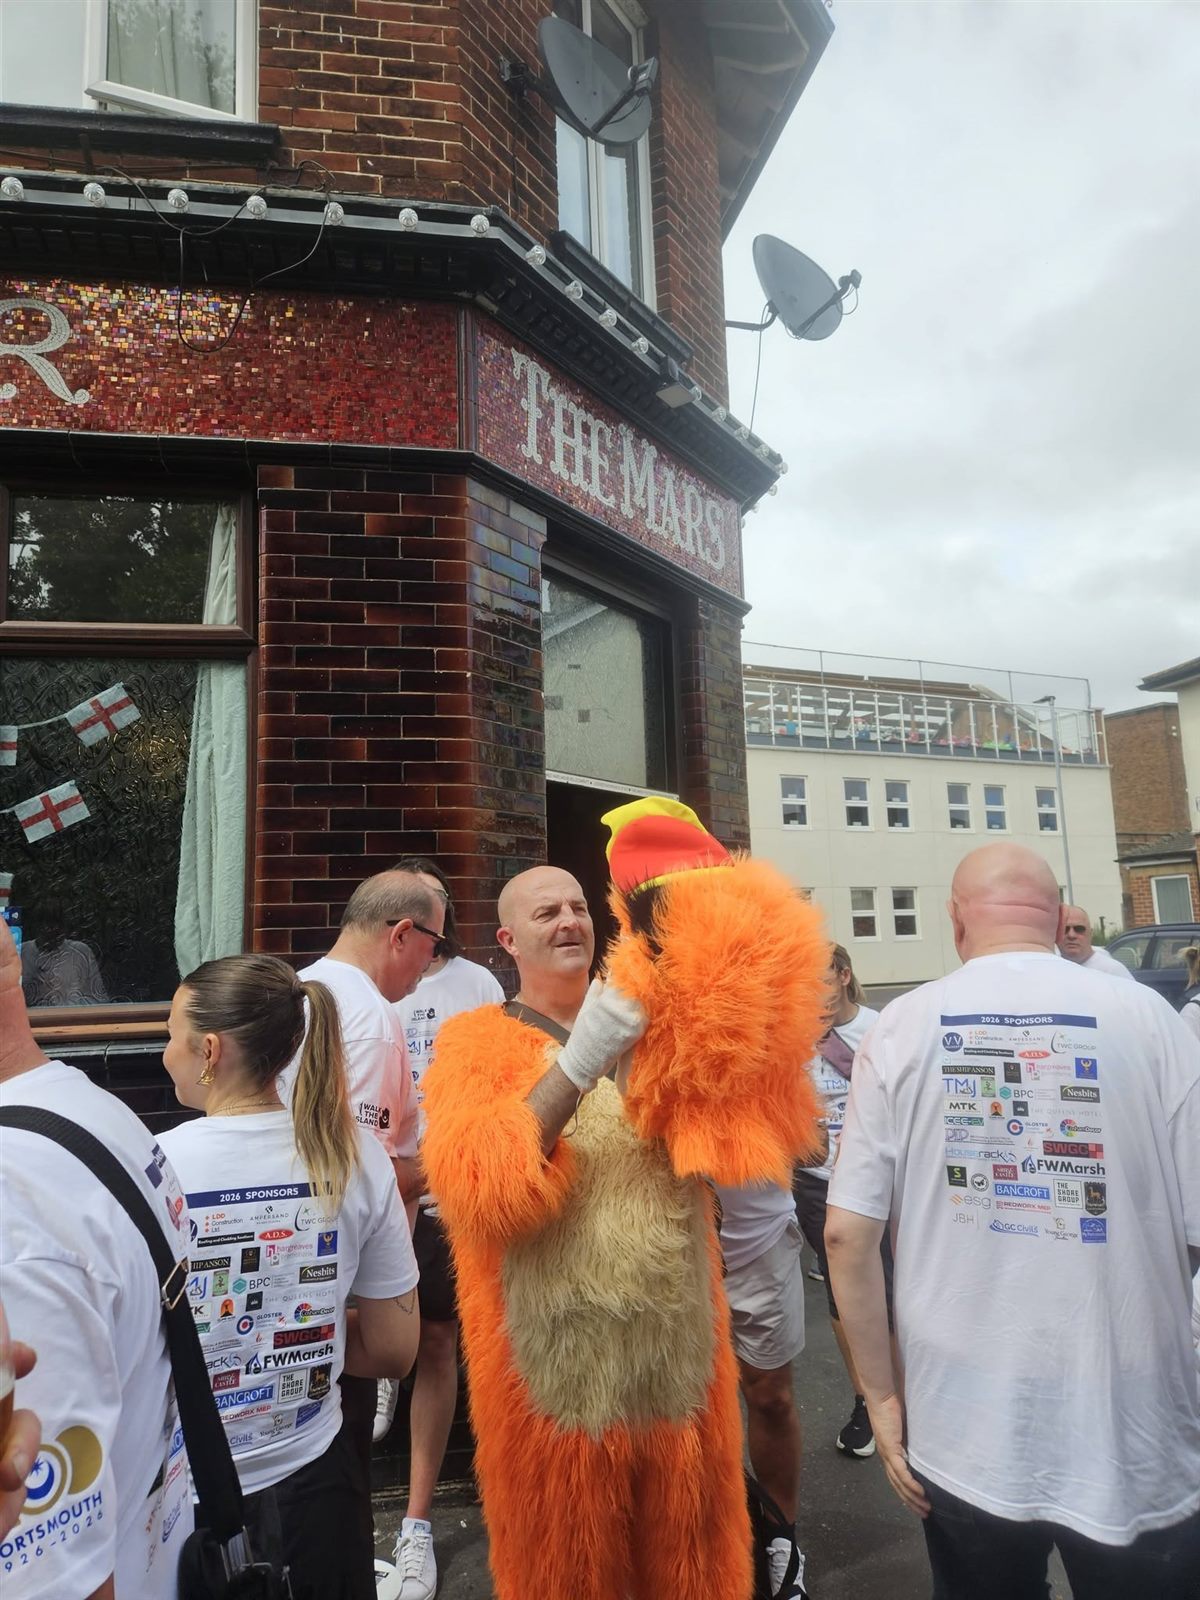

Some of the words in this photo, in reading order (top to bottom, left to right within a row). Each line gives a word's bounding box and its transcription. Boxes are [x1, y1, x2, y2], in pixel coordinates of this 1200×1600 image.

[511, 348, 616, 508] THE
[619, 423, 726, 570] MARS
[1004, 1016, 1053, 1024] SPONSORS
[942, 1078, 976, 1098] TMJ
[1067, 1088, 1097, 1097] Nesbits
[1014, 1090, 1033, 1098] BPC
[949, 1102, 976, 1110] MTK
[365, 1111, 378, 1119] THE
[1037, 1160, 1106, 1175] FWMarsh
[220, 1193, 240, 1202] 2026
[245, 1188, 298, 1199] SPONSORS
[997, 1185, 1047, 1198] BANCROFT
[964, 1195, 991, 1210] esg
[953, 1213, 974, 1224] JBH
[266, 1230, 288, 1238] A.D.S.
[204, 1258, 229, 1268] ANSON
[307, 1266, 335, 1278] Nesbits
[249, 1277, 270, 1290] BPC
[264, 1344, 333, 1368] FWMarsh
[282, 1379, 303, 1389] SHORE
[282, 1387, 303, 1397] GROUP
[230, 1432, 252, 1444] Civils
